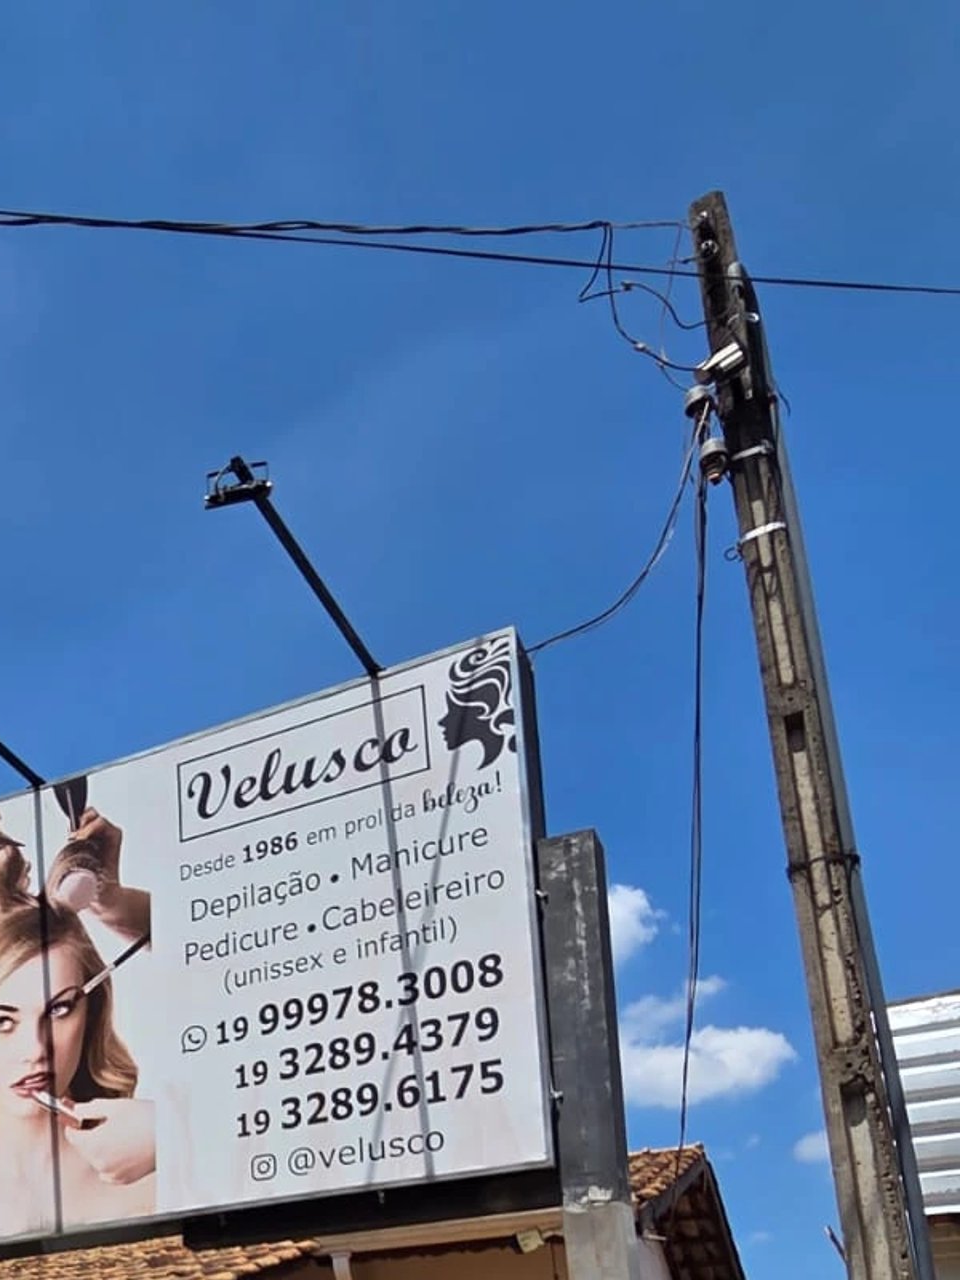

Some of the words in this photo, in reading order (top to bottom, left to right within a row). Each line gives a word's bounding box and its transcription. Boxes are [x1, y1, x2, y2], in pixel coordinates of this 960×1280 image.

[187, 727, 418, 820] Velusco
[180, 855, 236, 881] Desde
[242, 831, 299, 864] 1986
[306, 826, 337, 846] em
[344, 805, 382, 839] prol
[391, 801, 415, 823] da
[422, 771, 503, 813] beleza!
[184, 919, 299, 966] Pedicure
[322, 868, 506, 932] Cabeleireiro
[190, 871, 321, 922] Depilação
[351, 826, 489, 881] Manicure
[216, 1016, 249, 1046] 19
[258, 952, 505, 1036] 99978.3008
[223, 954, 324, 994] (unissex
[332, 947, 347, 966] e
[356, 914, 459, 960] infantil)
[235, 1060, 269, 1090] 19
[279, 1006, 500, 1080] 3289.4379
[237, 1109, 271, 1139] 19
[280, 1059, 505, 1131] 3289.6175
[287, 1130, 445, 1176] @velusco
